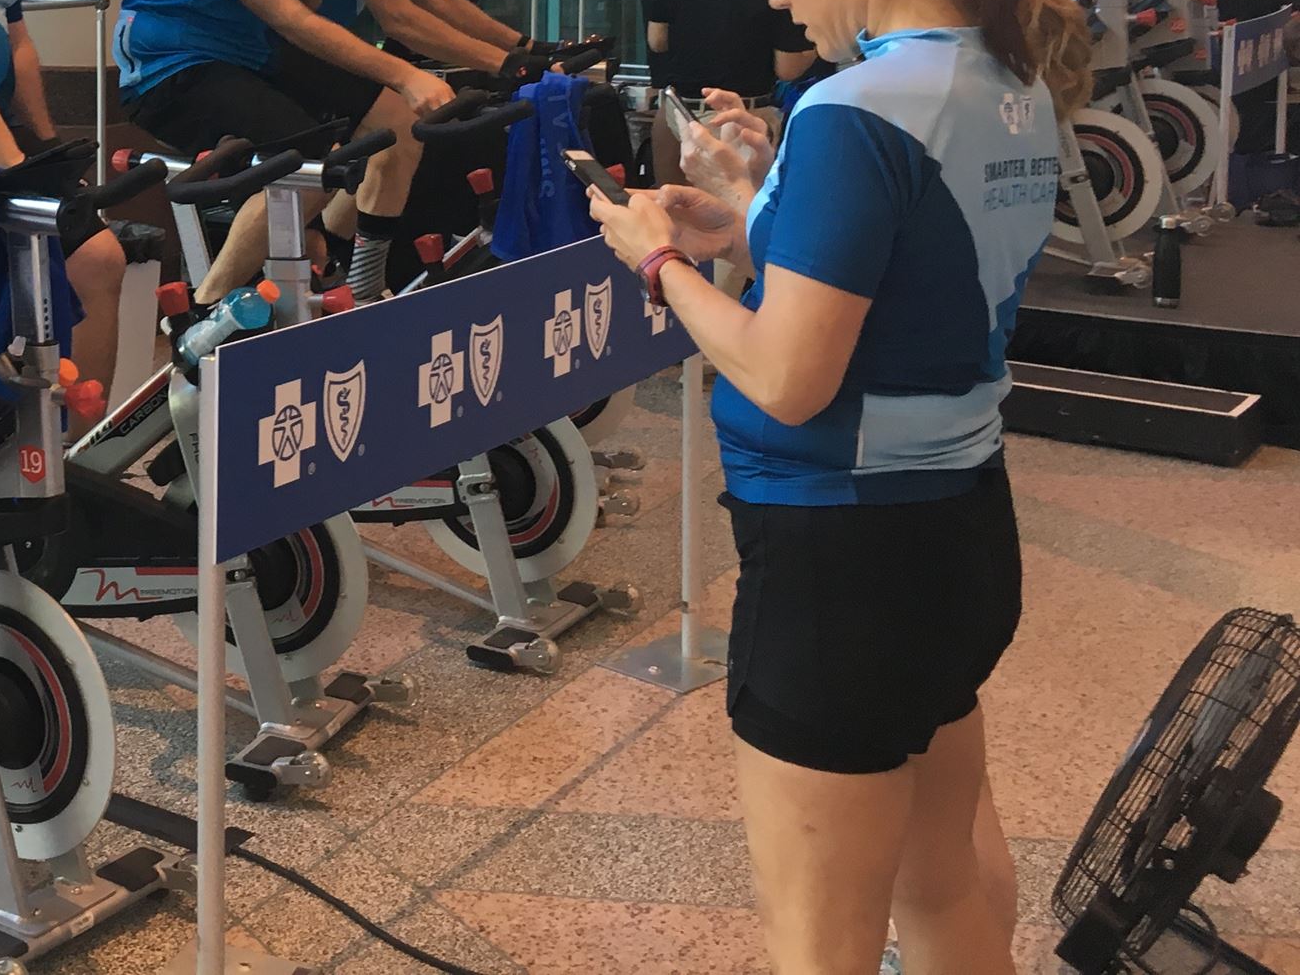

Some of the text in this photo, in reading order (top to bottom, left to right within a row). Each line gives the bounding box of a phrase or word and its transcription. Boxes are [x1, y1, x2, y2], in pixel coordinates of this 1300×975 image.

[1030, 156, 1061, 177] BETTE
[20, 449, 43, 474] 19
[139, 587, 198, 596] FREEMOTION
